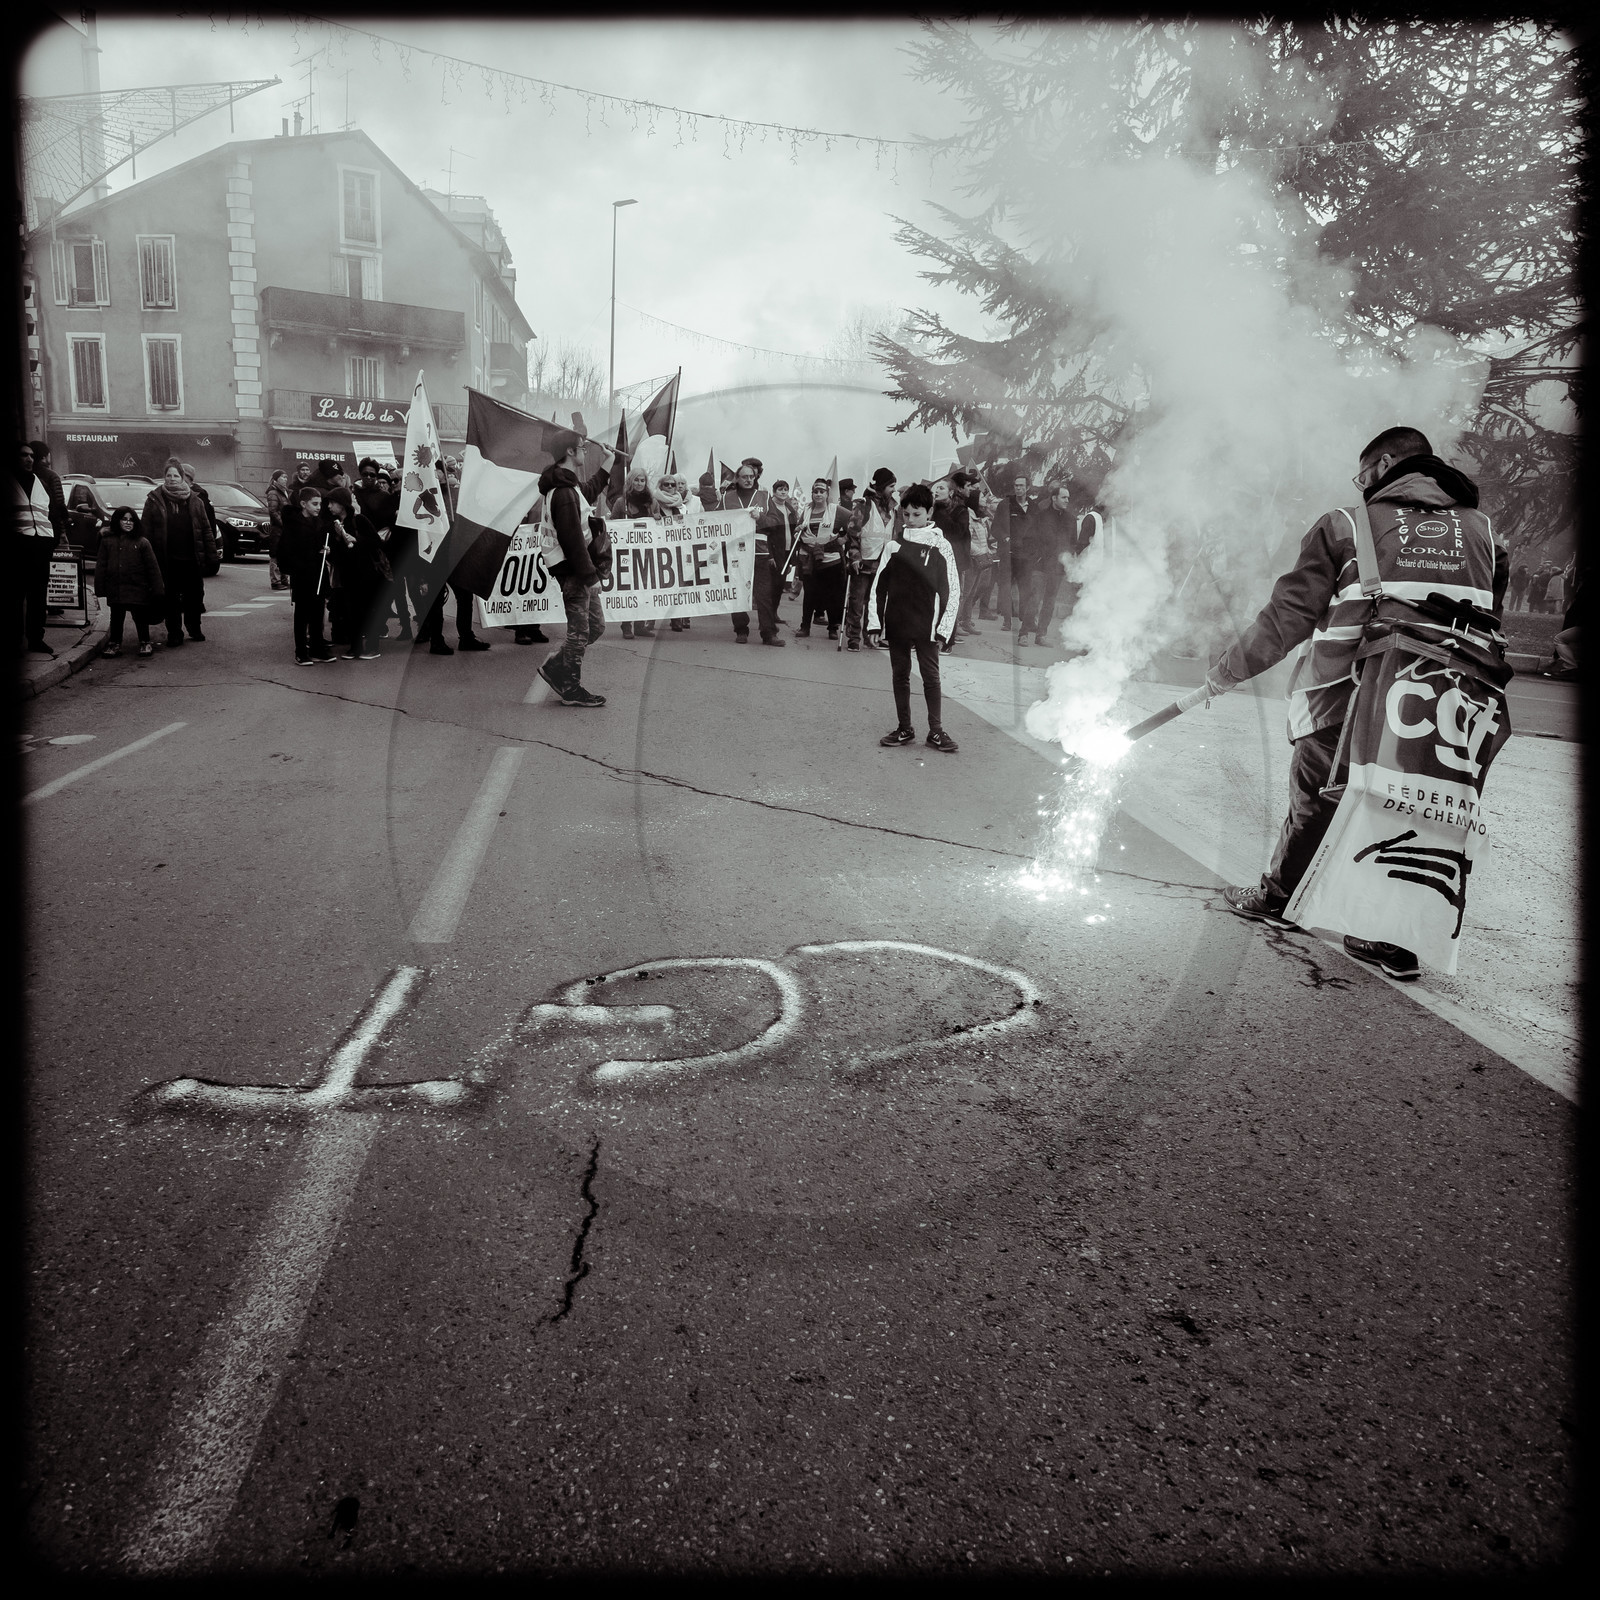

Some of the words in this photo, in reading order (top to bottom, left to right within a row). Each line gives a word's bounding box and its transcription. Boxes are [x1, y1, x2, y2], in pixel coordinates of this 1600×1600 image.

[317, 398, 339, 418] La
[343, 401, 376, 420] table
[379, 409, 395, 423] de
[394, 410, 411, 424] V
[66, 434, 119, 442] RESTAURANT
[295, 452, 346, 462] BRASSERIE
[625, 531, 653, 544] JEUNES
[665, 525, 692, 542] PRIVÉS
[696, 523, 732, 539] D'EMPLOI
[1395, 517, 1409, 545] TGV
[1452, 518, 1463, 548] TER
[1400, 547, 1465, 558] CORAIL
[500, 552, 547, 597] OUS
[1396, 556, 1416, 568] Déclaré
[1439, 561, 1460, 573] Publique
[523, 598, 549, 612] EMPLOI
[606, 596, 638, 609] PUBLICS
[653, 591, 701, 607] PROTECTION
[705, 588, 737, 602] SOCIALE
[1386, 680, 1500, 779] cgt
[1383, 798, 1416, 815] DES
